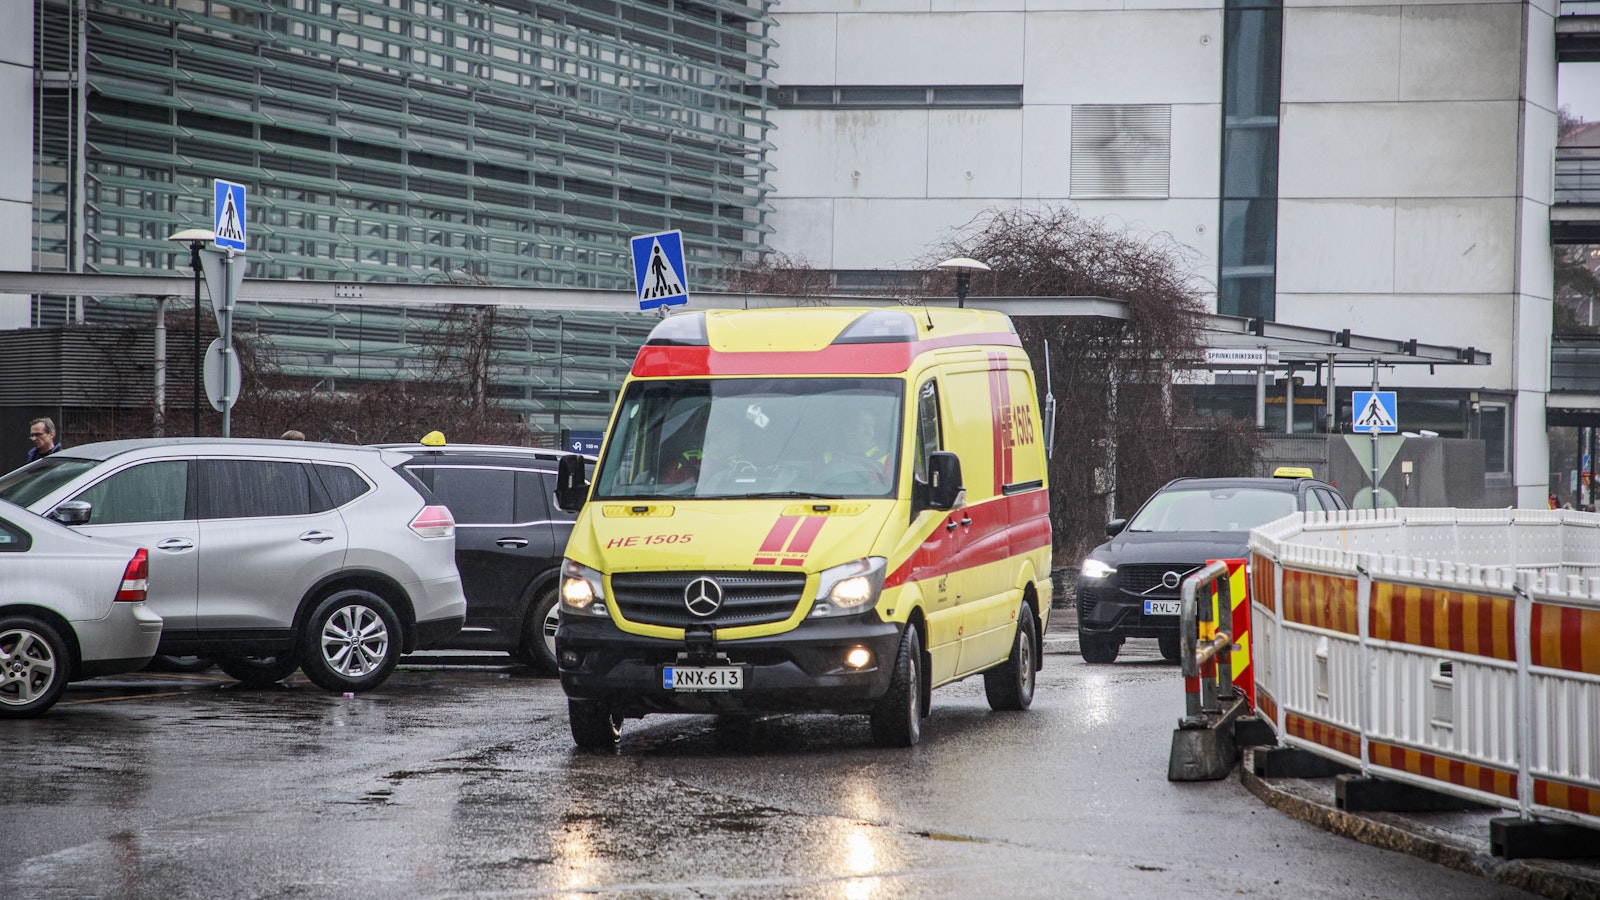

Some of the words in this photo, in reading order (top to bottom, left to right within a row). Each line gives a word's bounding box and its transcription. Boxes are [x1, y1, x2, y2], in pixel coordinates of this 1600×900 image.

[1208, 352, 1263, 360] SPRINKLERIKESKUS
[1013, 404, 1033, 446] 1505
[607, 535, 641, 549] HE
[644, 533, 693, 545] 1505
[1152, 603, 1181, 613] RVL-7
[675, 671, 739, 685] XNX-613
